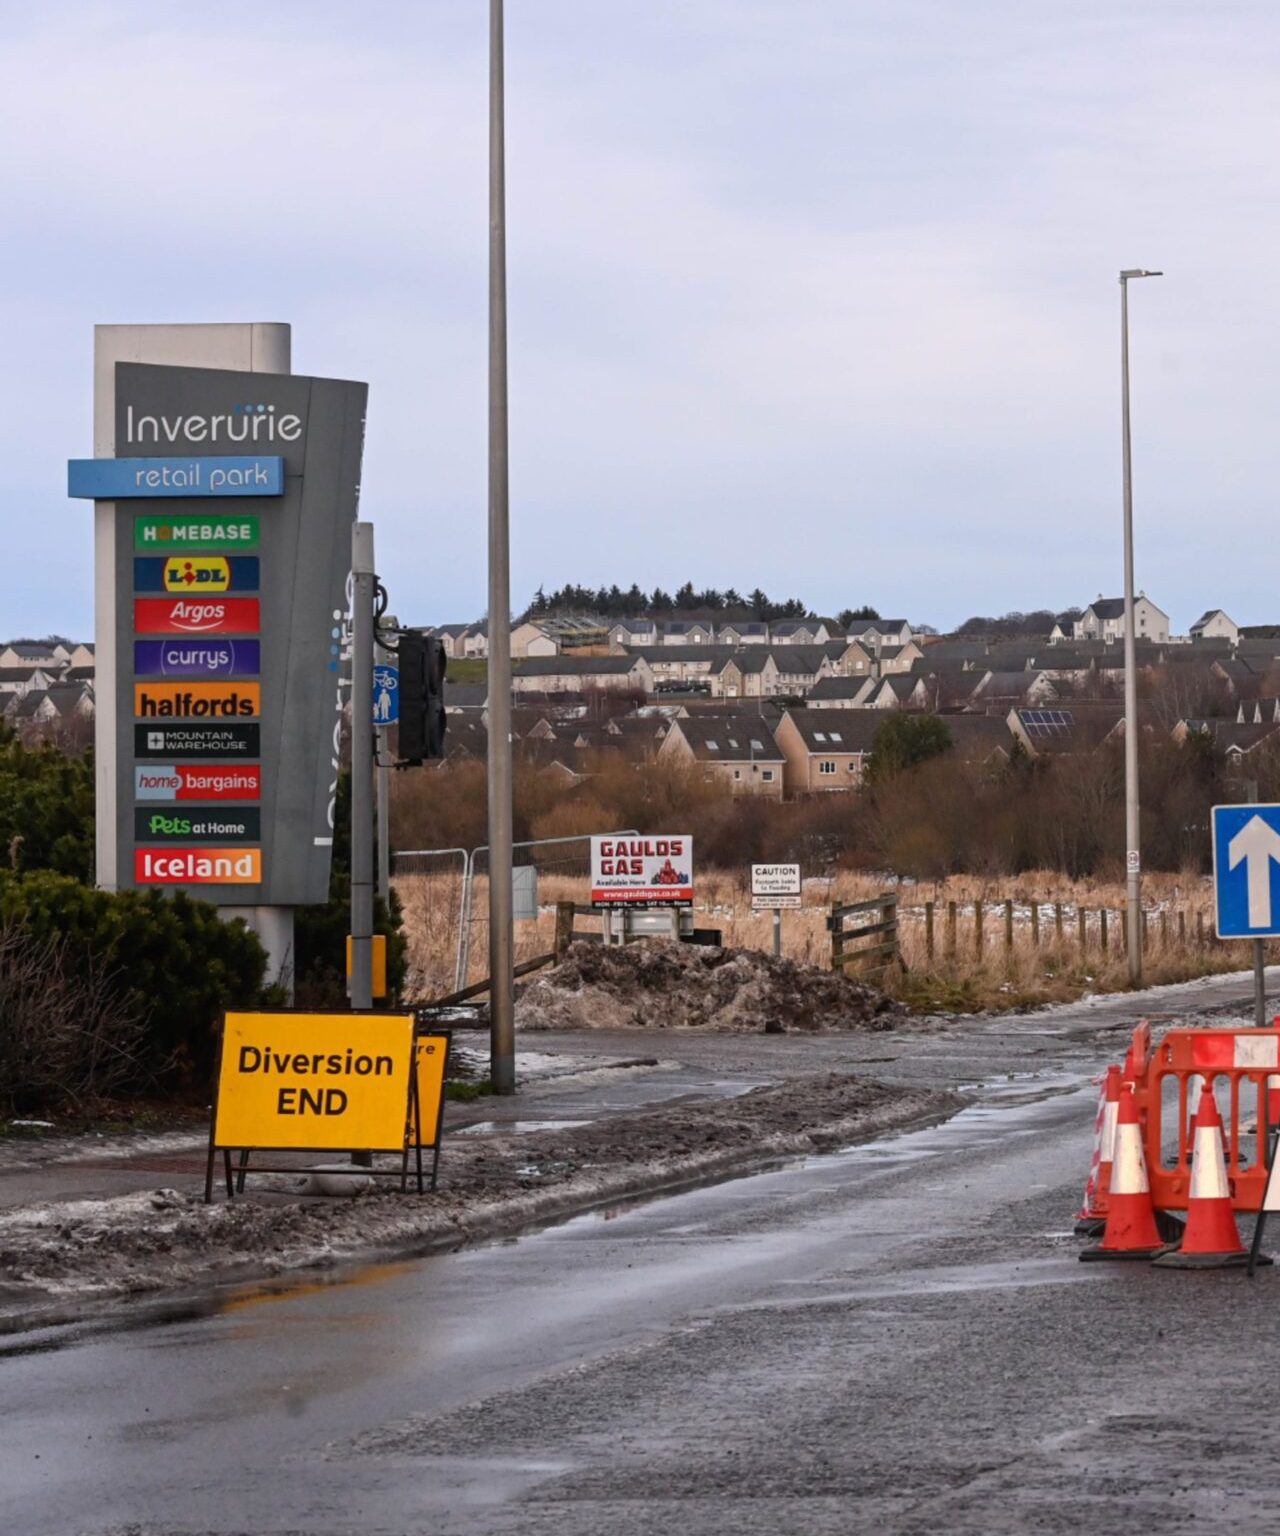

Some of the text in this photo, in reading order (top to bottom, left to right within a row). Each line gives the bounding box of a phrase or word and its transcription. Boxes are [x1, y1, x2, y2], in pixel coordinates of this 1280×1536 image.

[127, 405, 302, 442] Inverurie
[136, 463, 268, 490] retail park
[143, 524, 251, 541] HOMEBASE
[170, 601, 225, 623] Argos
[167, 650, 229, 669] currys
[140, 692, 255, 717] halfords
[165, 740, 247, 750] WAREHOUSE
[166, 731, 233, 741] MOUNTAIN
[139, 773, 257, 792] home bargains
[149, 814, 246, 835] Pets at Home
[600, 840, 683, 857] GAULDS
[143, 853, 253, 878] Iceland
[601, 859, 644, 875] GAS
[755, 867, 796, 876] CAUTION
[595, 879, 628, 887] Available
[238, 1046, 393, 1076] Diversion
[276, 1088, 348, 1116] END
